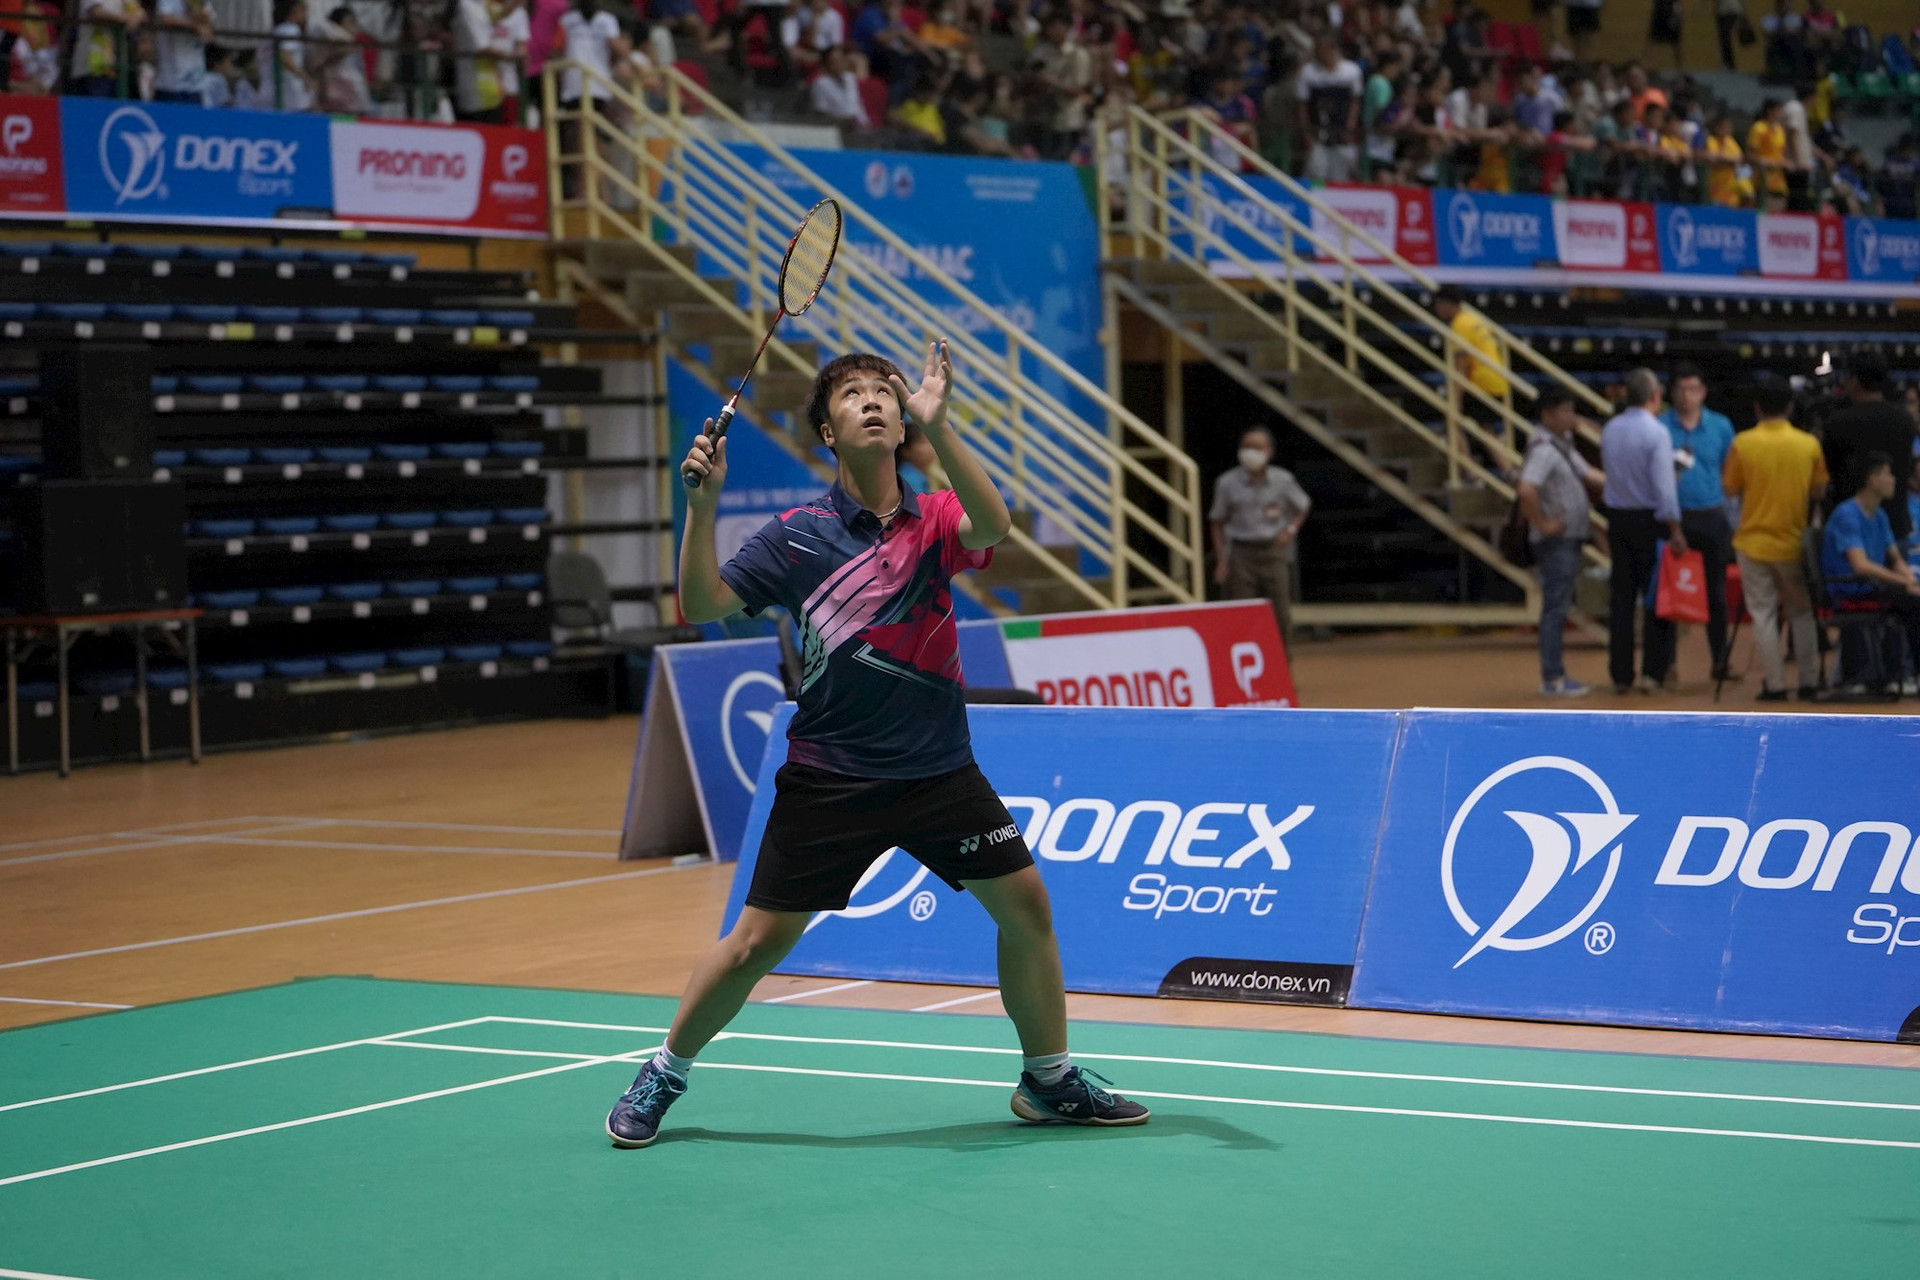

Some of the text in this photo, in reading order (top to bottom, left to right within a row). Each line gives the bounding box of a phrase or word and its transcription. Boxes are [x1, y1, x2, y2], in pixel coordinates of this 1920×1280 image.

[174, 134, 300, 175] DONEX
[357, 148, 466, 181] PRONING
[983, 823, 1021, 846] YONEX
[1654, 815, 1920, 895] DON
[1122, 872, 1278, 920] Sport
[1190, 970, 1331, 994] www.donex.vn
